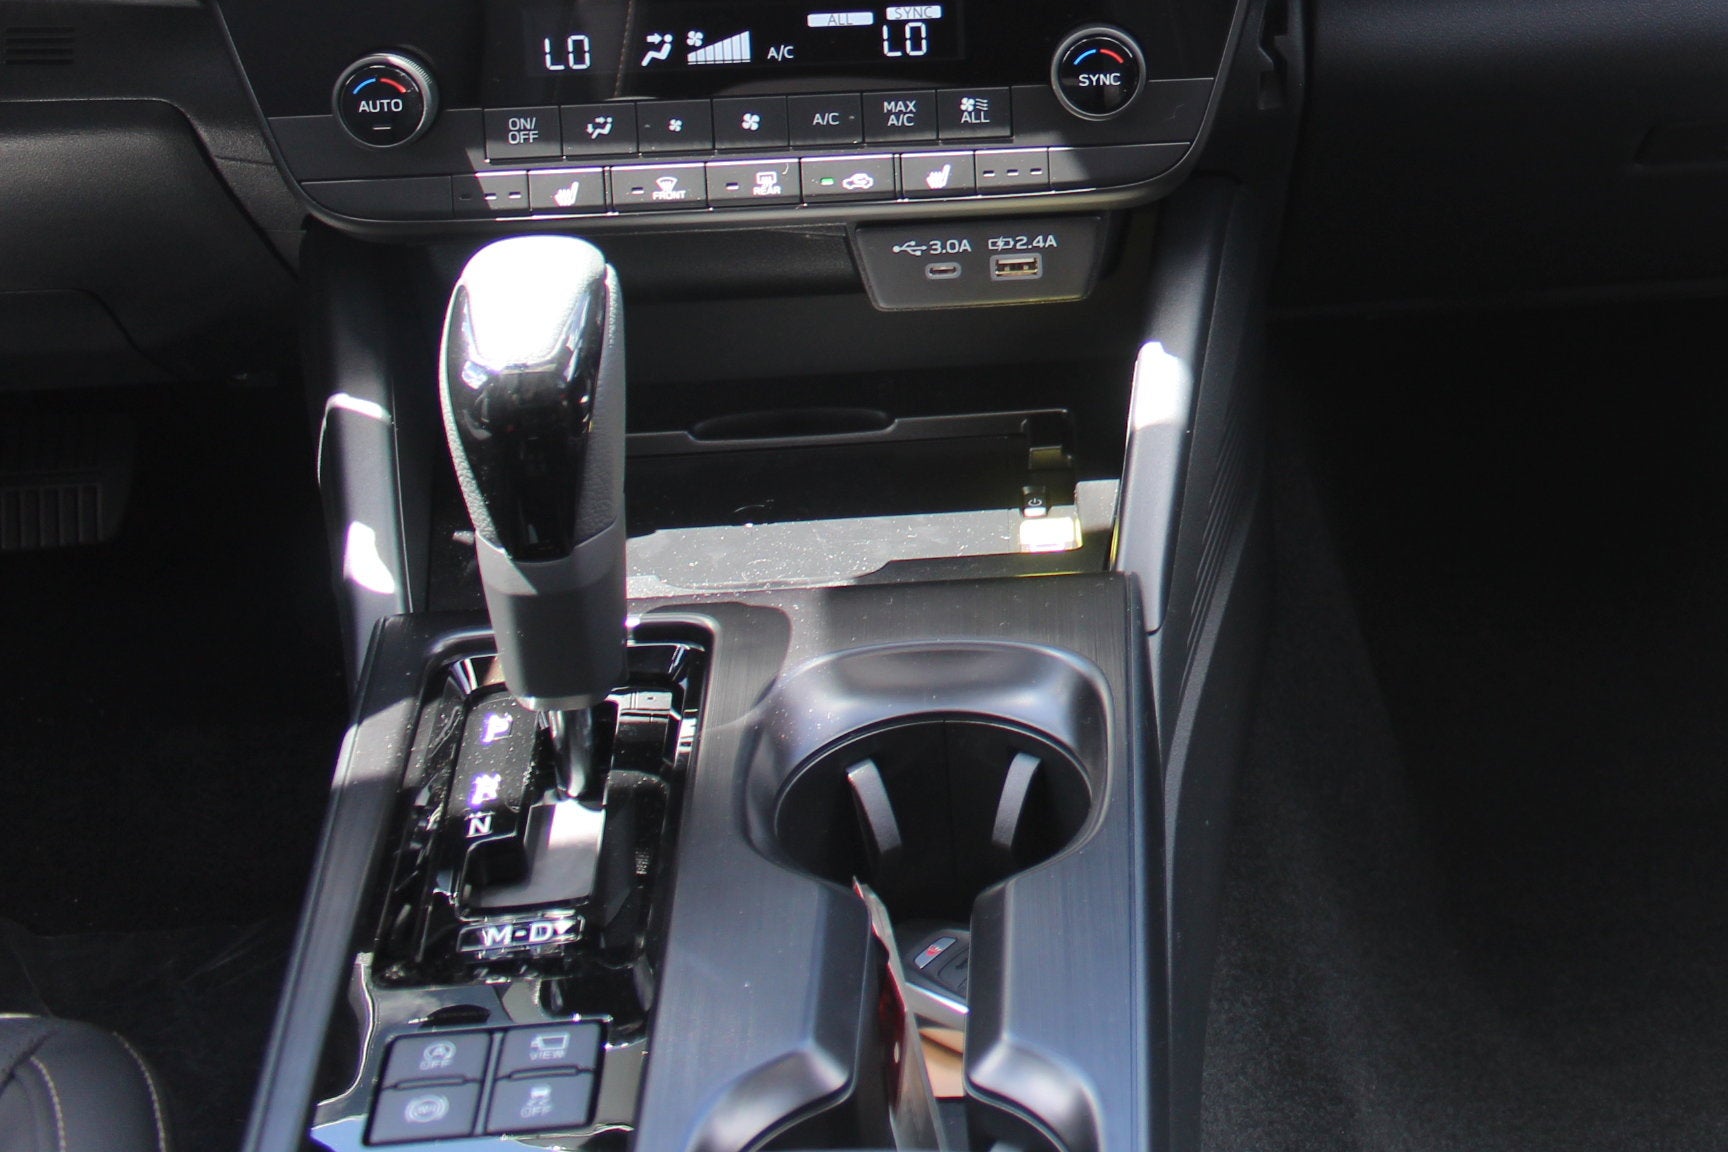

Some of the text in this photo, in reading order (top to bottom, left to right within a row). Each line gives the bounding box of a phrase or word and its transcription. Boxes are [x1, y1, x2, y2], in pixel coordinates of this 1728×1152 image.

[827, 14, 854, 26] ALL
[894, 6, 934, 20] SYNC
[767, 45, 795, 61] A/C
[1078, 72, 1122, 88] SYNC
[358, 98, 403, 113] AUTO
[883, 100, 916, 114] MAX
[508, 117, 536, 131] ON/
[812, 112, 840, 126] A/C
[887, 113, 915, 128] A/C
[960, 111, 990, 124] ALL
[508, 130, 539, 145] OFF
[651, 189, 687, 201] FRONT
[752, 184, 781, 196] REAR
[929, 239, 972, 255] 3.0A
[1015, 235, 1058, 250] 2.4A
[468, 816, 493, 837] N
[528, 1048, 567, 1061] VIEW
[419, 1059, 450, 1071] OFF
[520, 1104, 552, 1119] OFF
